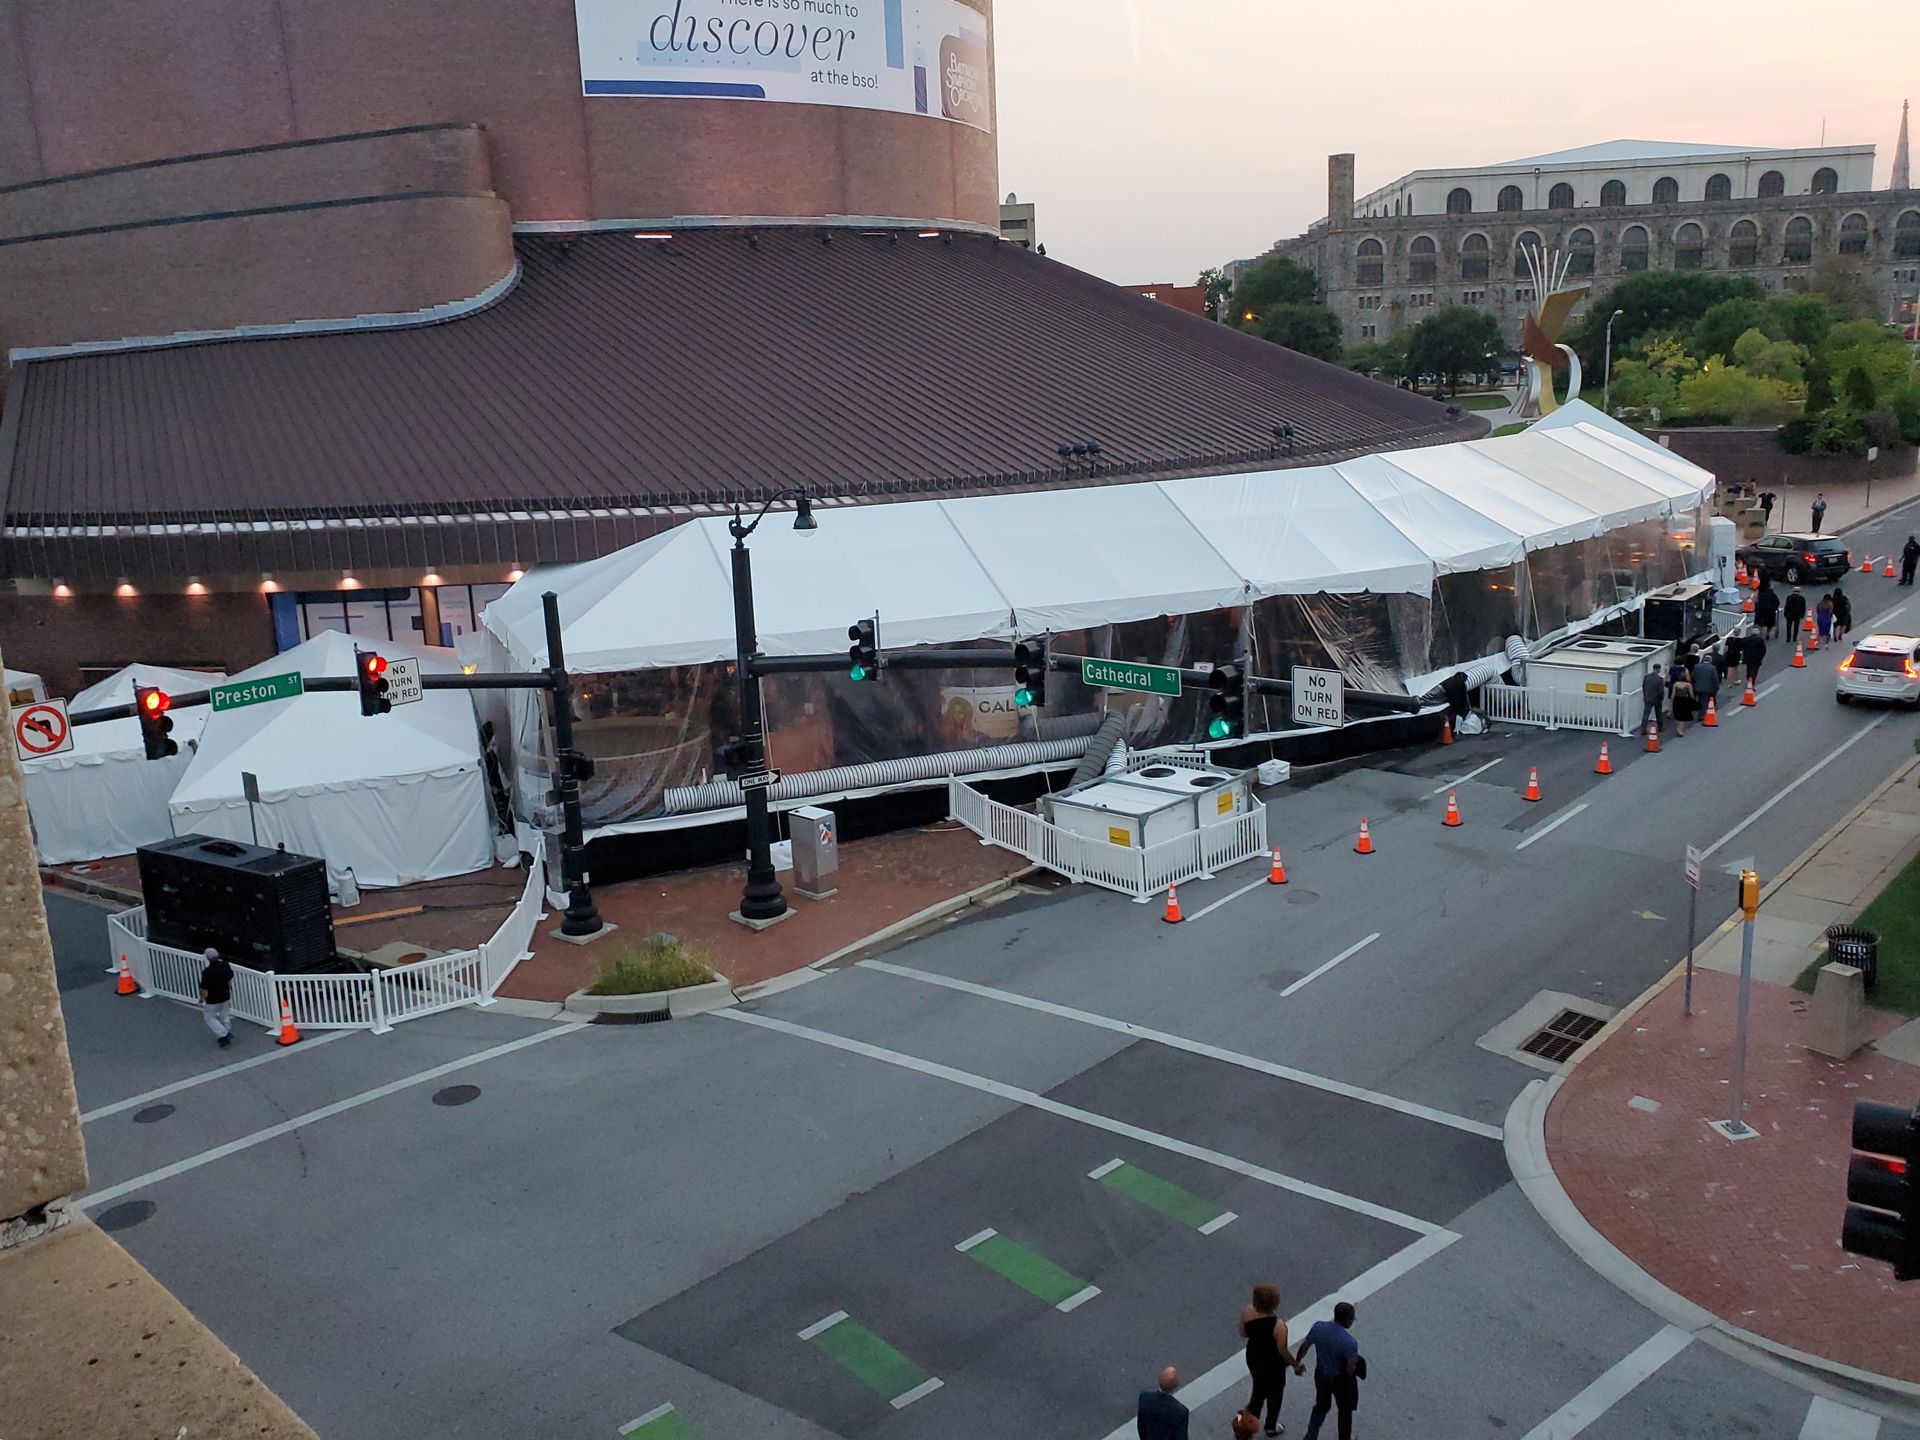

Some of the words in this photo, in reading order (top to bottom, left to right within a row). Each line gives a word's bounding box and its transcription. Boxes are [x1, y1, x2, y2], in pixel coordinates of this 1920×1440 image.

[768, 0, 779, 8] is
[783, 0, 800, 10] so
[804, 1, 841, 15] much
[845, 4, 858, 17] to
[649, 0, 856, 62] discover
[810, 69, 824, 83] at
[827, 69, 849, 85] the
[852, 71, 878, 89] bso!
[392, 665, 406, 675] NO
[1086, 664, 1152, 687] Cathedral
[1166, 672, 1176, 681] ST
[389, 676, 412, 688] TURN
[1309, 675, 1326, 688] NO
[214, 684, 277, 707] Preston
[288, 675, 298, 684] ST
[386, 691, 398, 700] ON
[402, 687, 419, 699] RED
[1303, 690, 1332, 704] TURN
[1297, 704, 1312, 716] ON
[1317, 707, 1339, 720] RED
[757, 775, 769, 783] WAY
